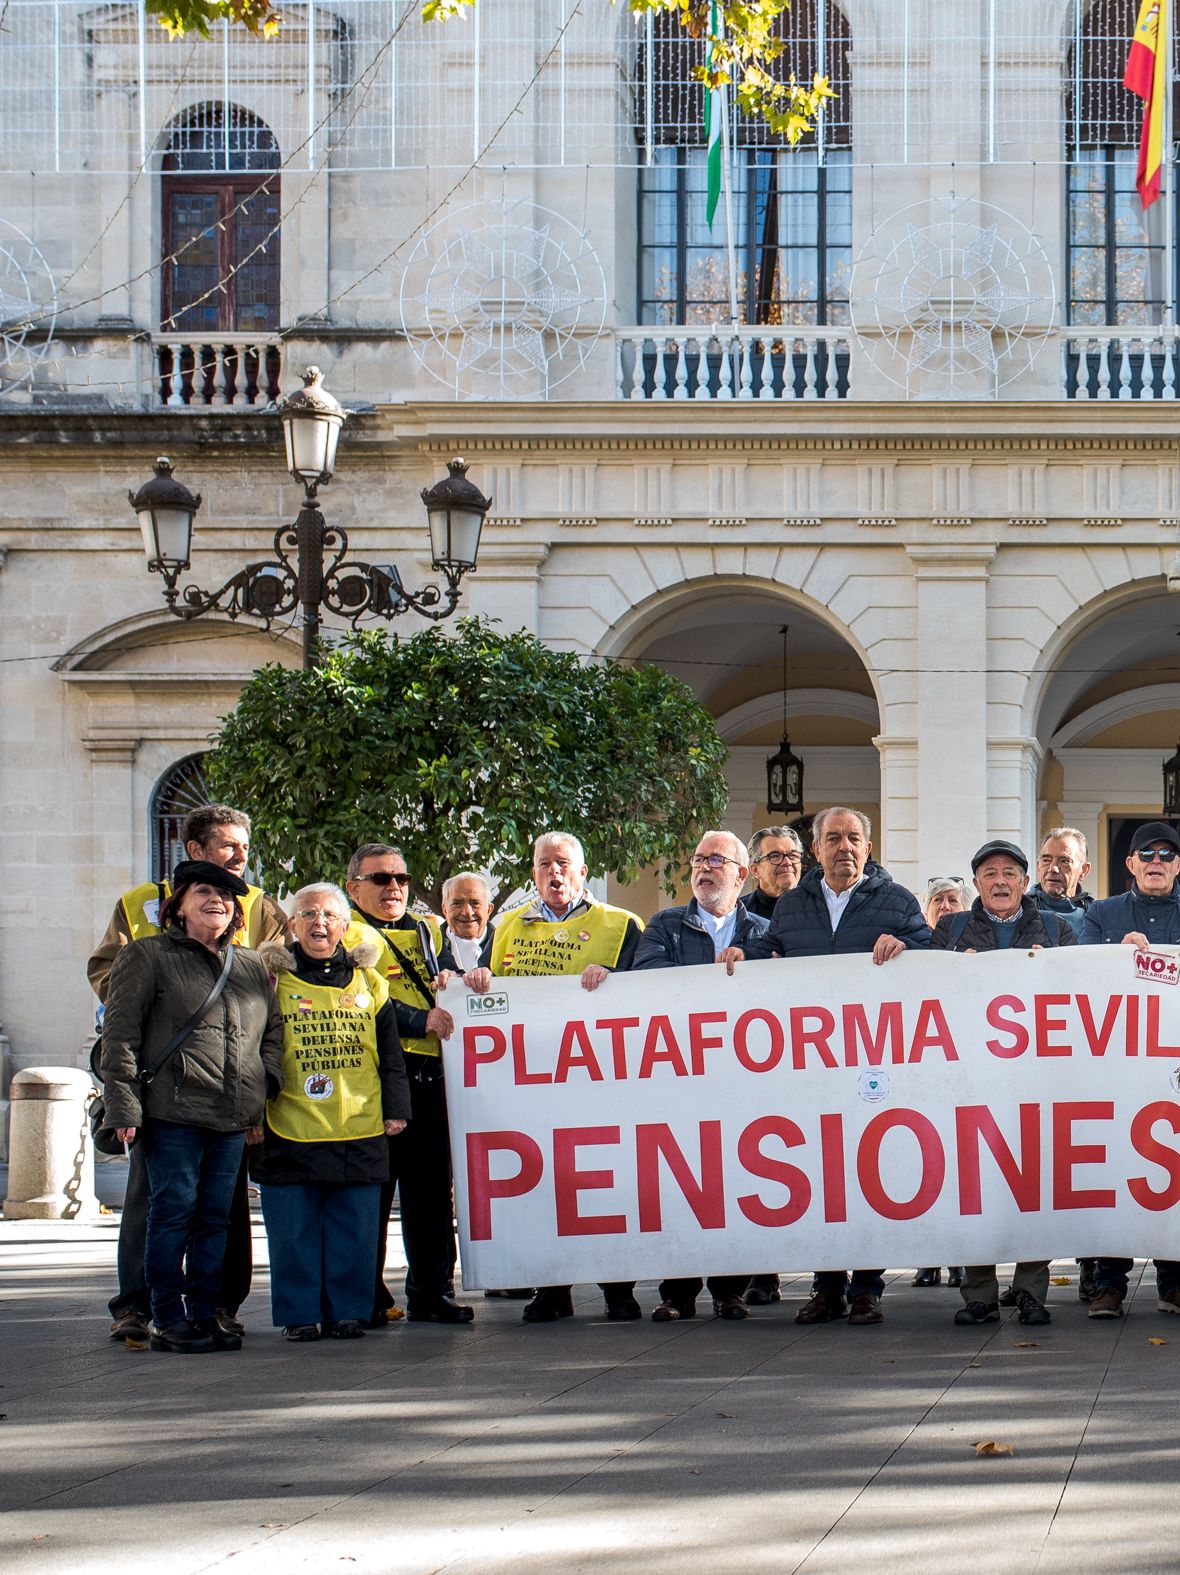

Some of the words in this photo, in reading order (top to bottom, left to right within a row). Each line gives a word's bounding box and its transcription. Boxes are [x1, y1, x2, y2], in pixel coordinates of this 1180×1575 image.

[1136, 954, 1178, 974] NO+
[1138, 969, 1176, 982] RECARIEDAD
[470, 996, 506, 1010] NO+
[283, 1009, 372, 1023] PLATAFORMA
[293, 1022, 366, 1034] SEVILLANA
[301, 1034, 361, 1046] DEFENSA
[463, 1000, 959, 1088] PLATAFORMA
[295, 1045, 365, 1060] PENSIONES
[301, 1057, 362, 1072] PÚBLICAS
